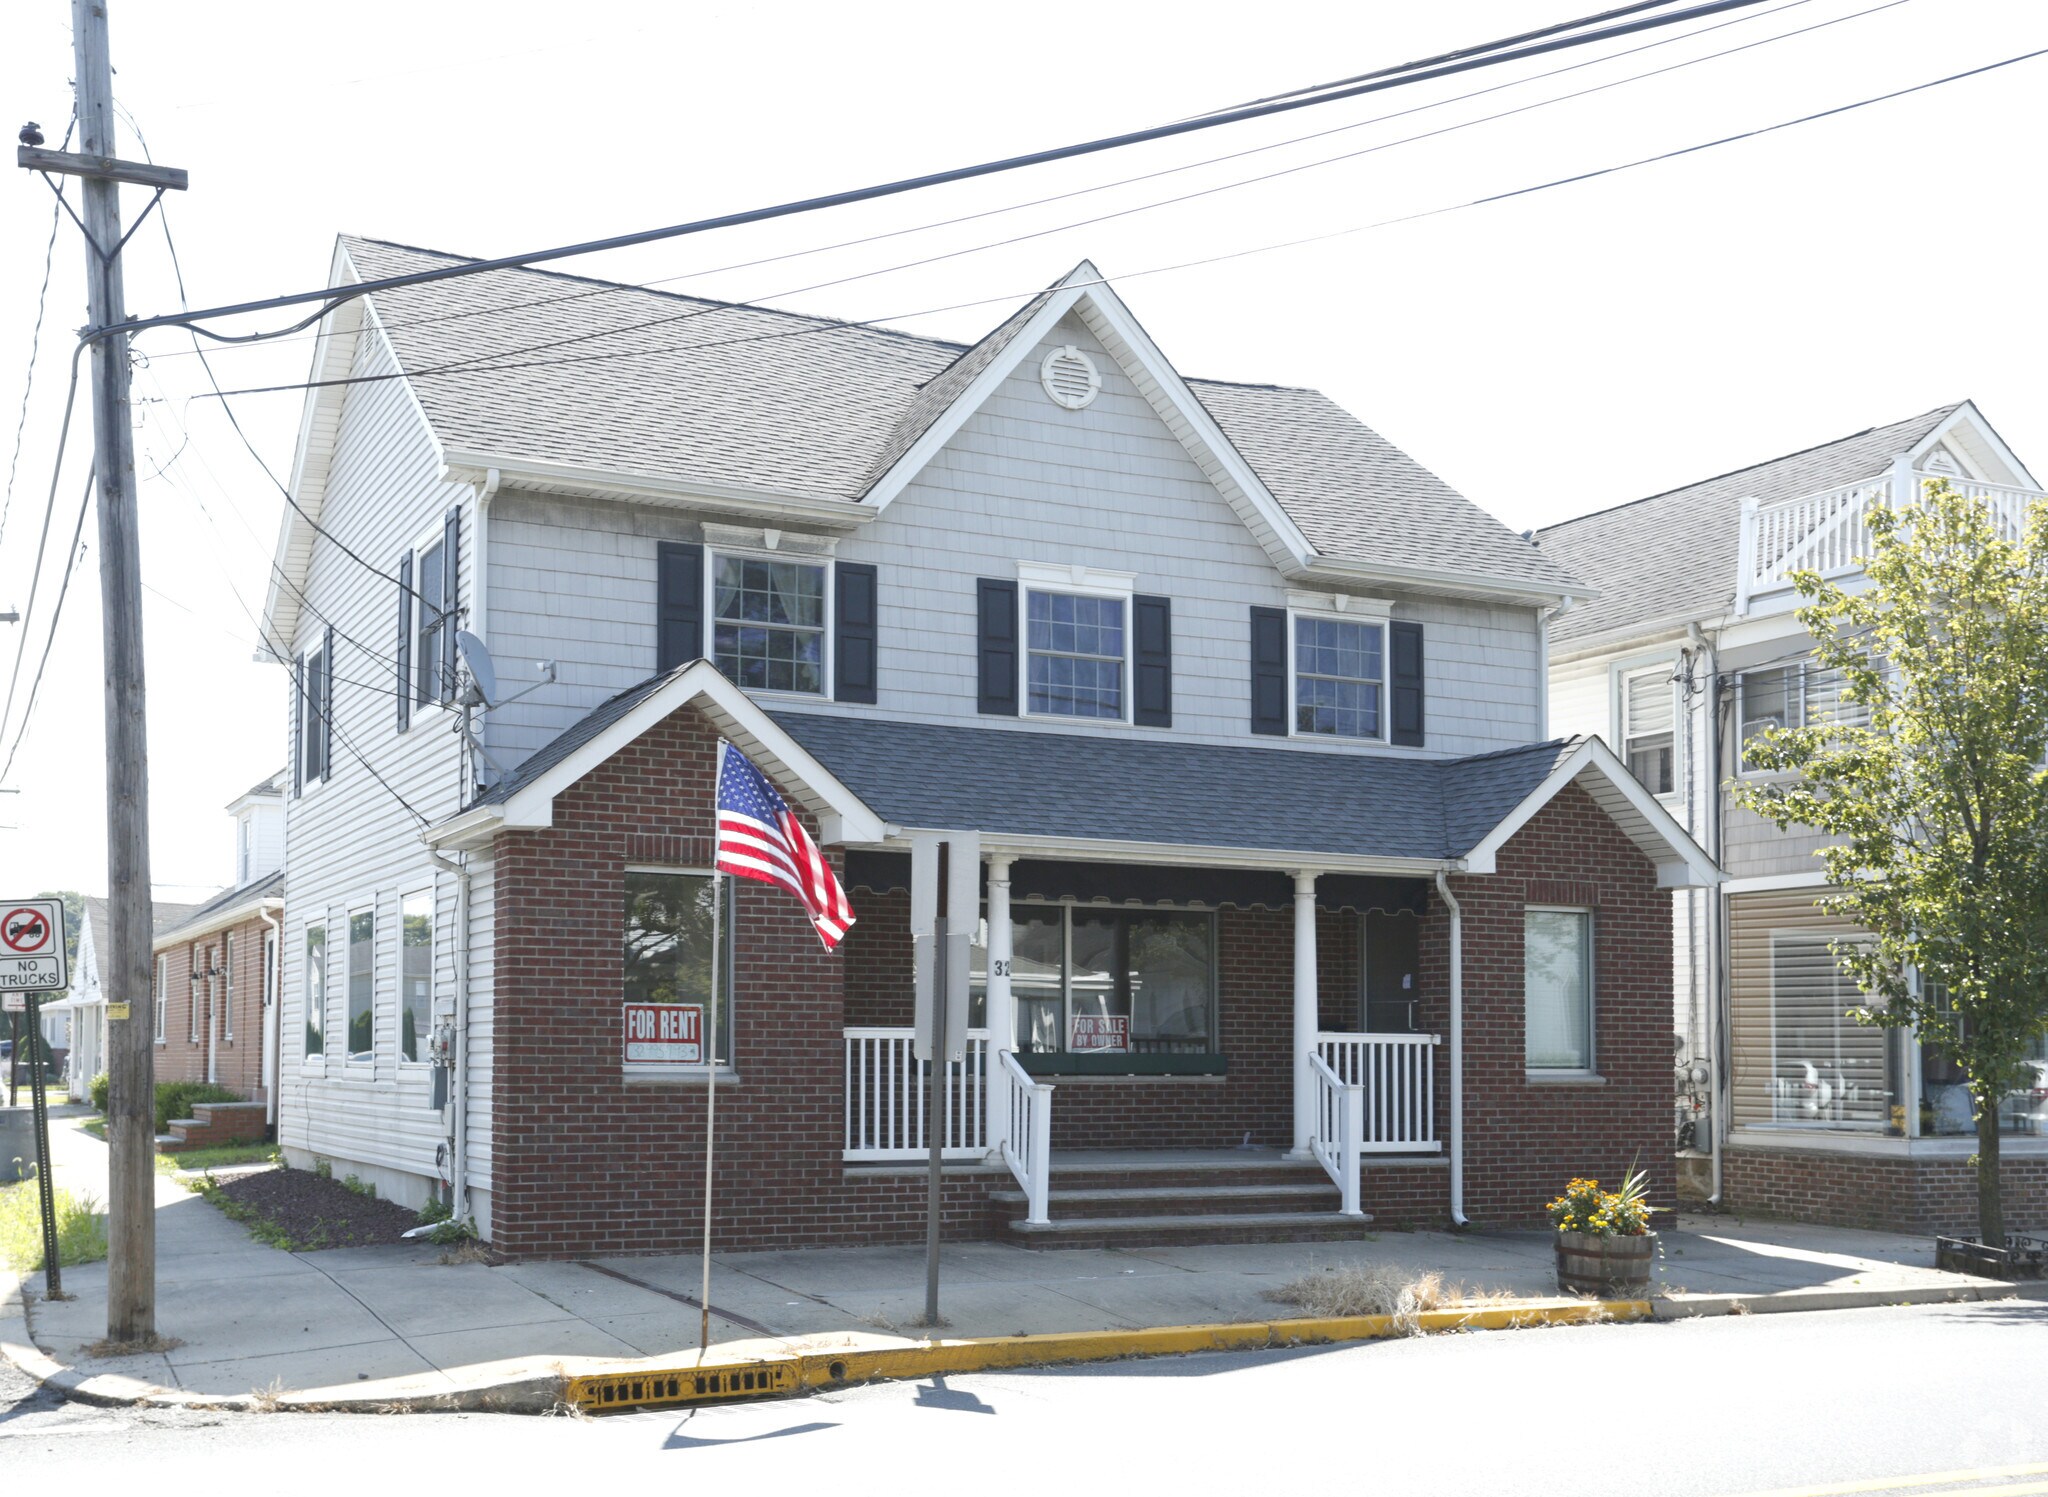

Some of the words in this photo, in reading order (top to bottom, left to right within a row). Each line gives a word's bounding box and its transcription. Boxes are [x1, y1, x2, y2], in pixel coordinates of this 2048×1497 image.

[18, 960, 38, 972] NO
[0, 972, 57, 986] TRUCKS
[628, 1009, 656, 1039] FOR
[660, 1010, 698, 1040] RENT
[1073, 1018, 1094, 1034] FOR
[1098, 1018, 1125, 1034] SALE
[1076, 1034, 1088, 1046] BY
[1091, 1034, 1123, 1047] OWNER
